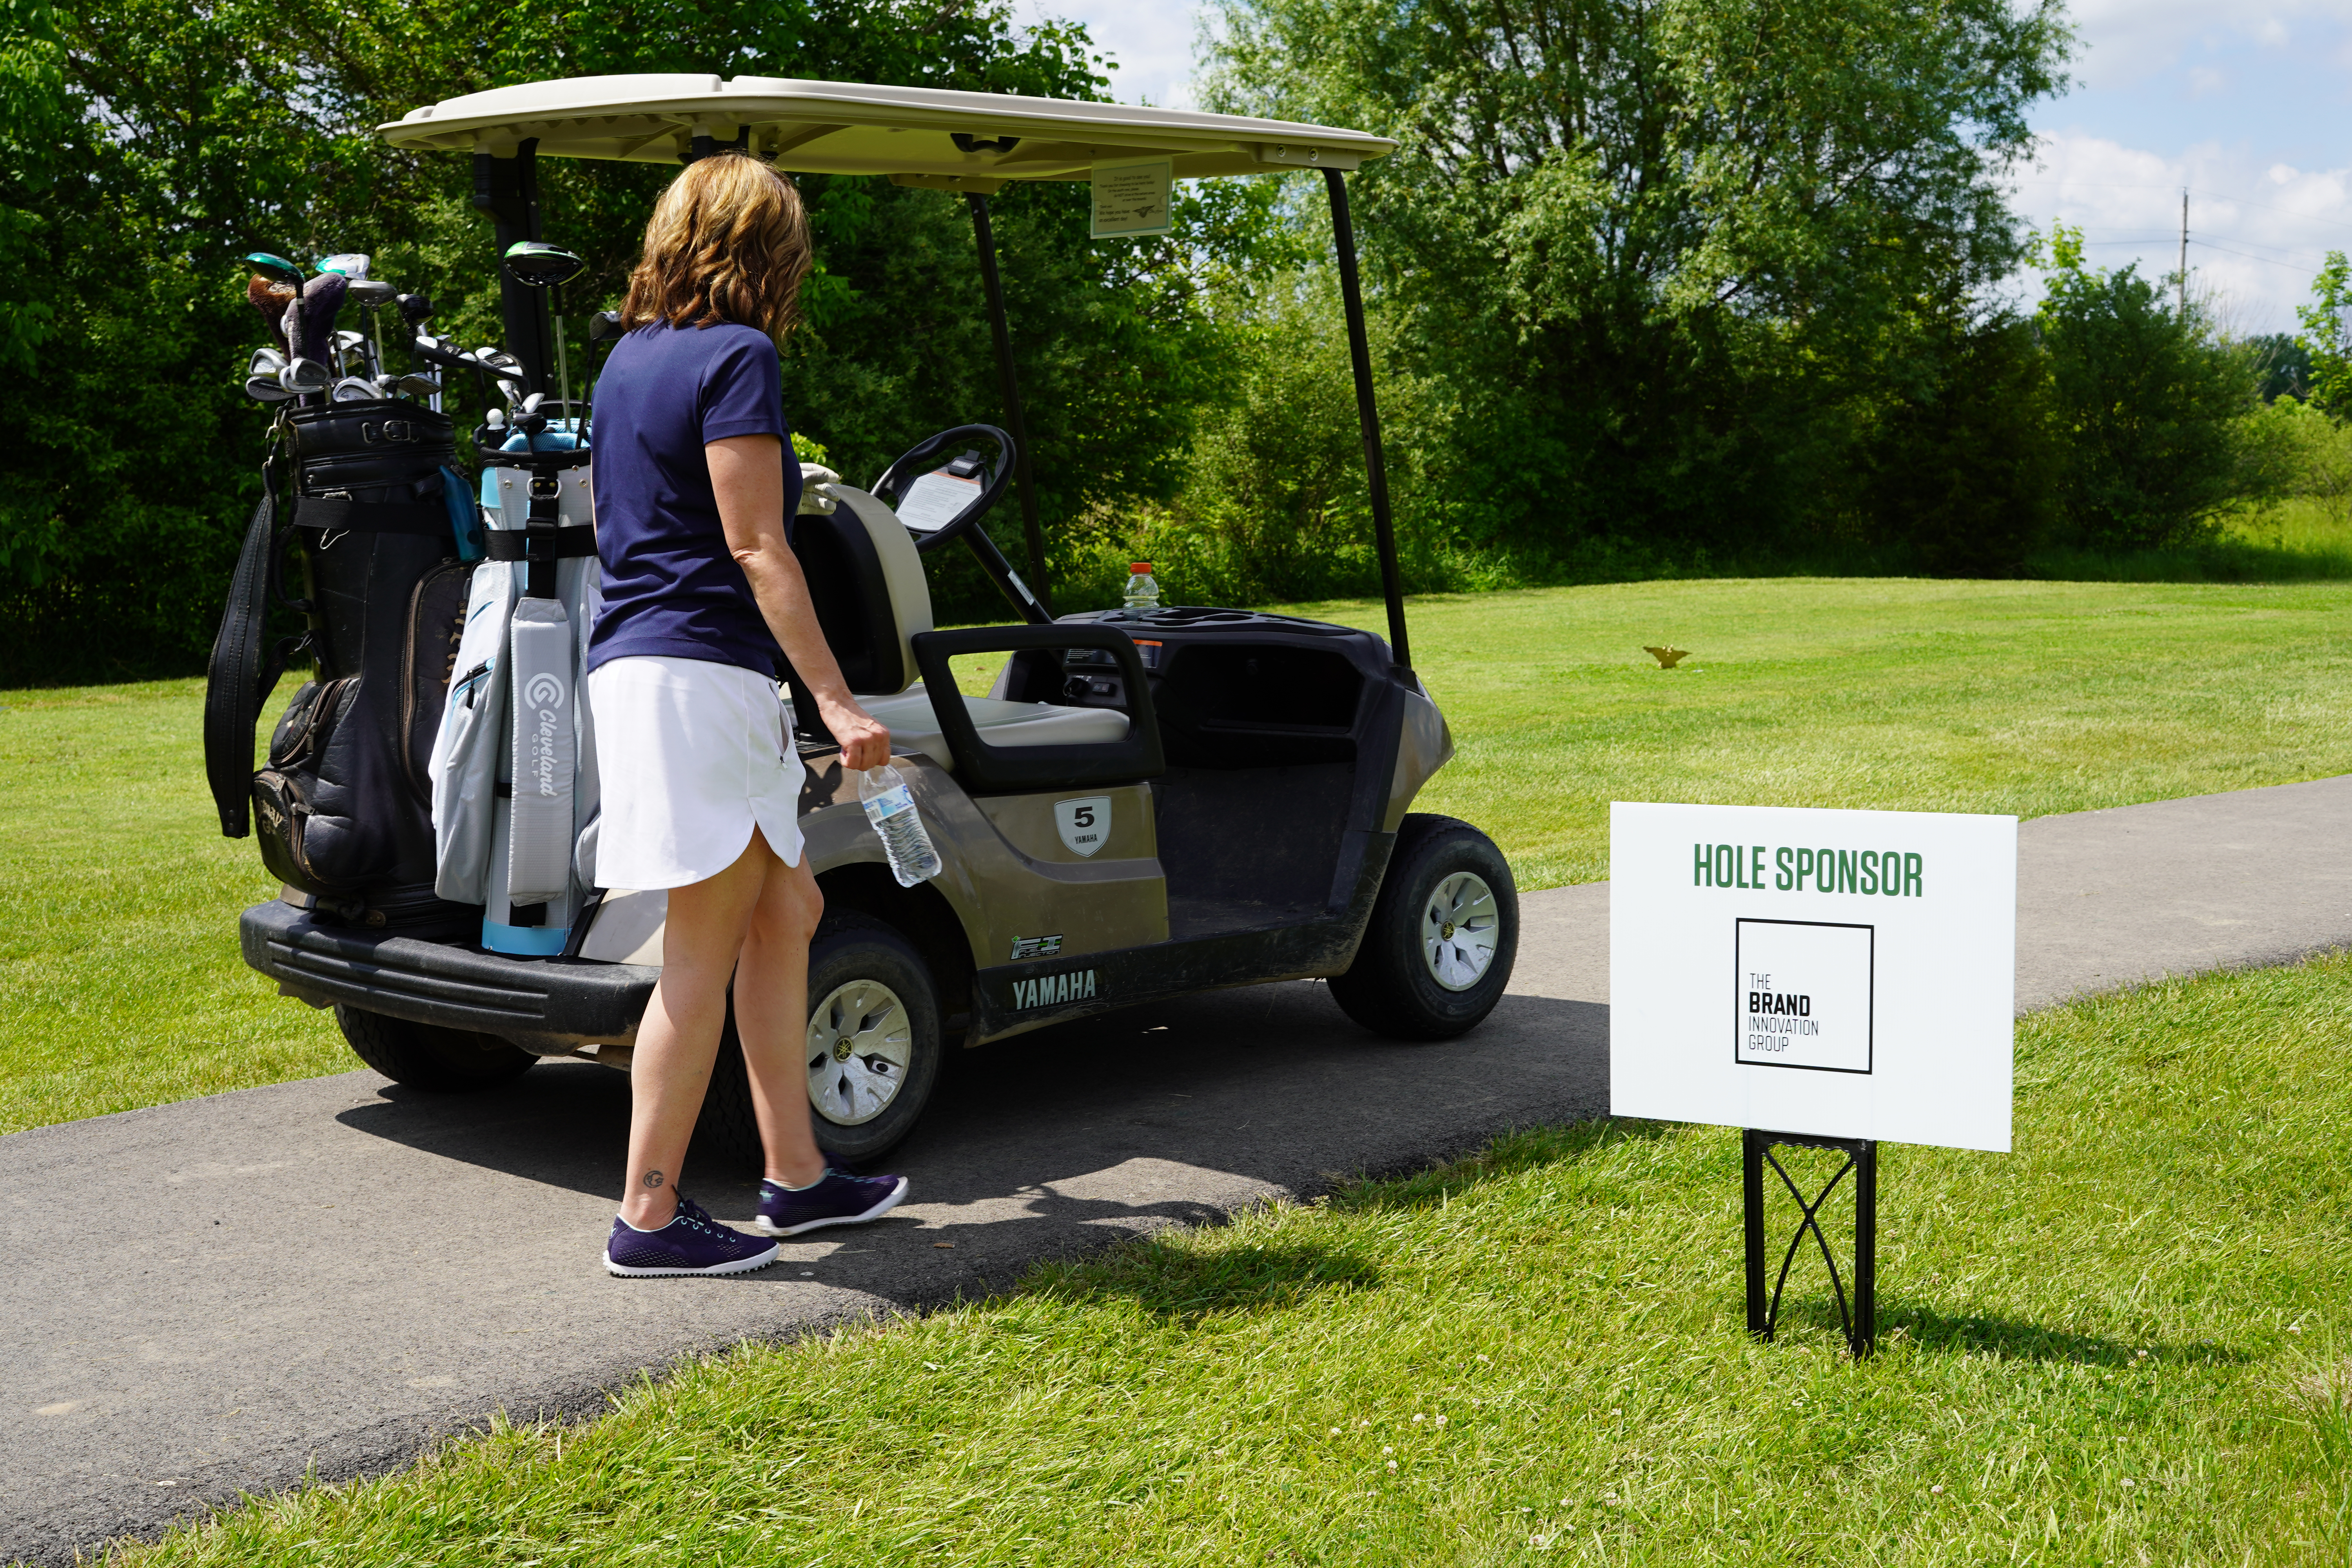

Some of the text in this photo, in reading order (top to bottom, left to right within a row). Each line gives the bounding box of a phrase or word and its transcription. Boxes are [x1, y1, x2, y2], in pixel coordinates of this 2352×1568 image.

[539, 709, 558, 797] Cleveland
[1074, 806, 1094, 827] 5
[1075, 834, 1097, 844] YAMAHA
[1695, 844, 1922, 897] HOLE SPONSOR
[1013, 969, 1096, 1010] YAMAHA
[1749, 973, 1771, 990] THE
[1749, 992, 1810, 1016] BRAND
[1749, 1016, 1818, 1036] INNOVATION
[1749, 1034, 1788, 1052] GROUP
